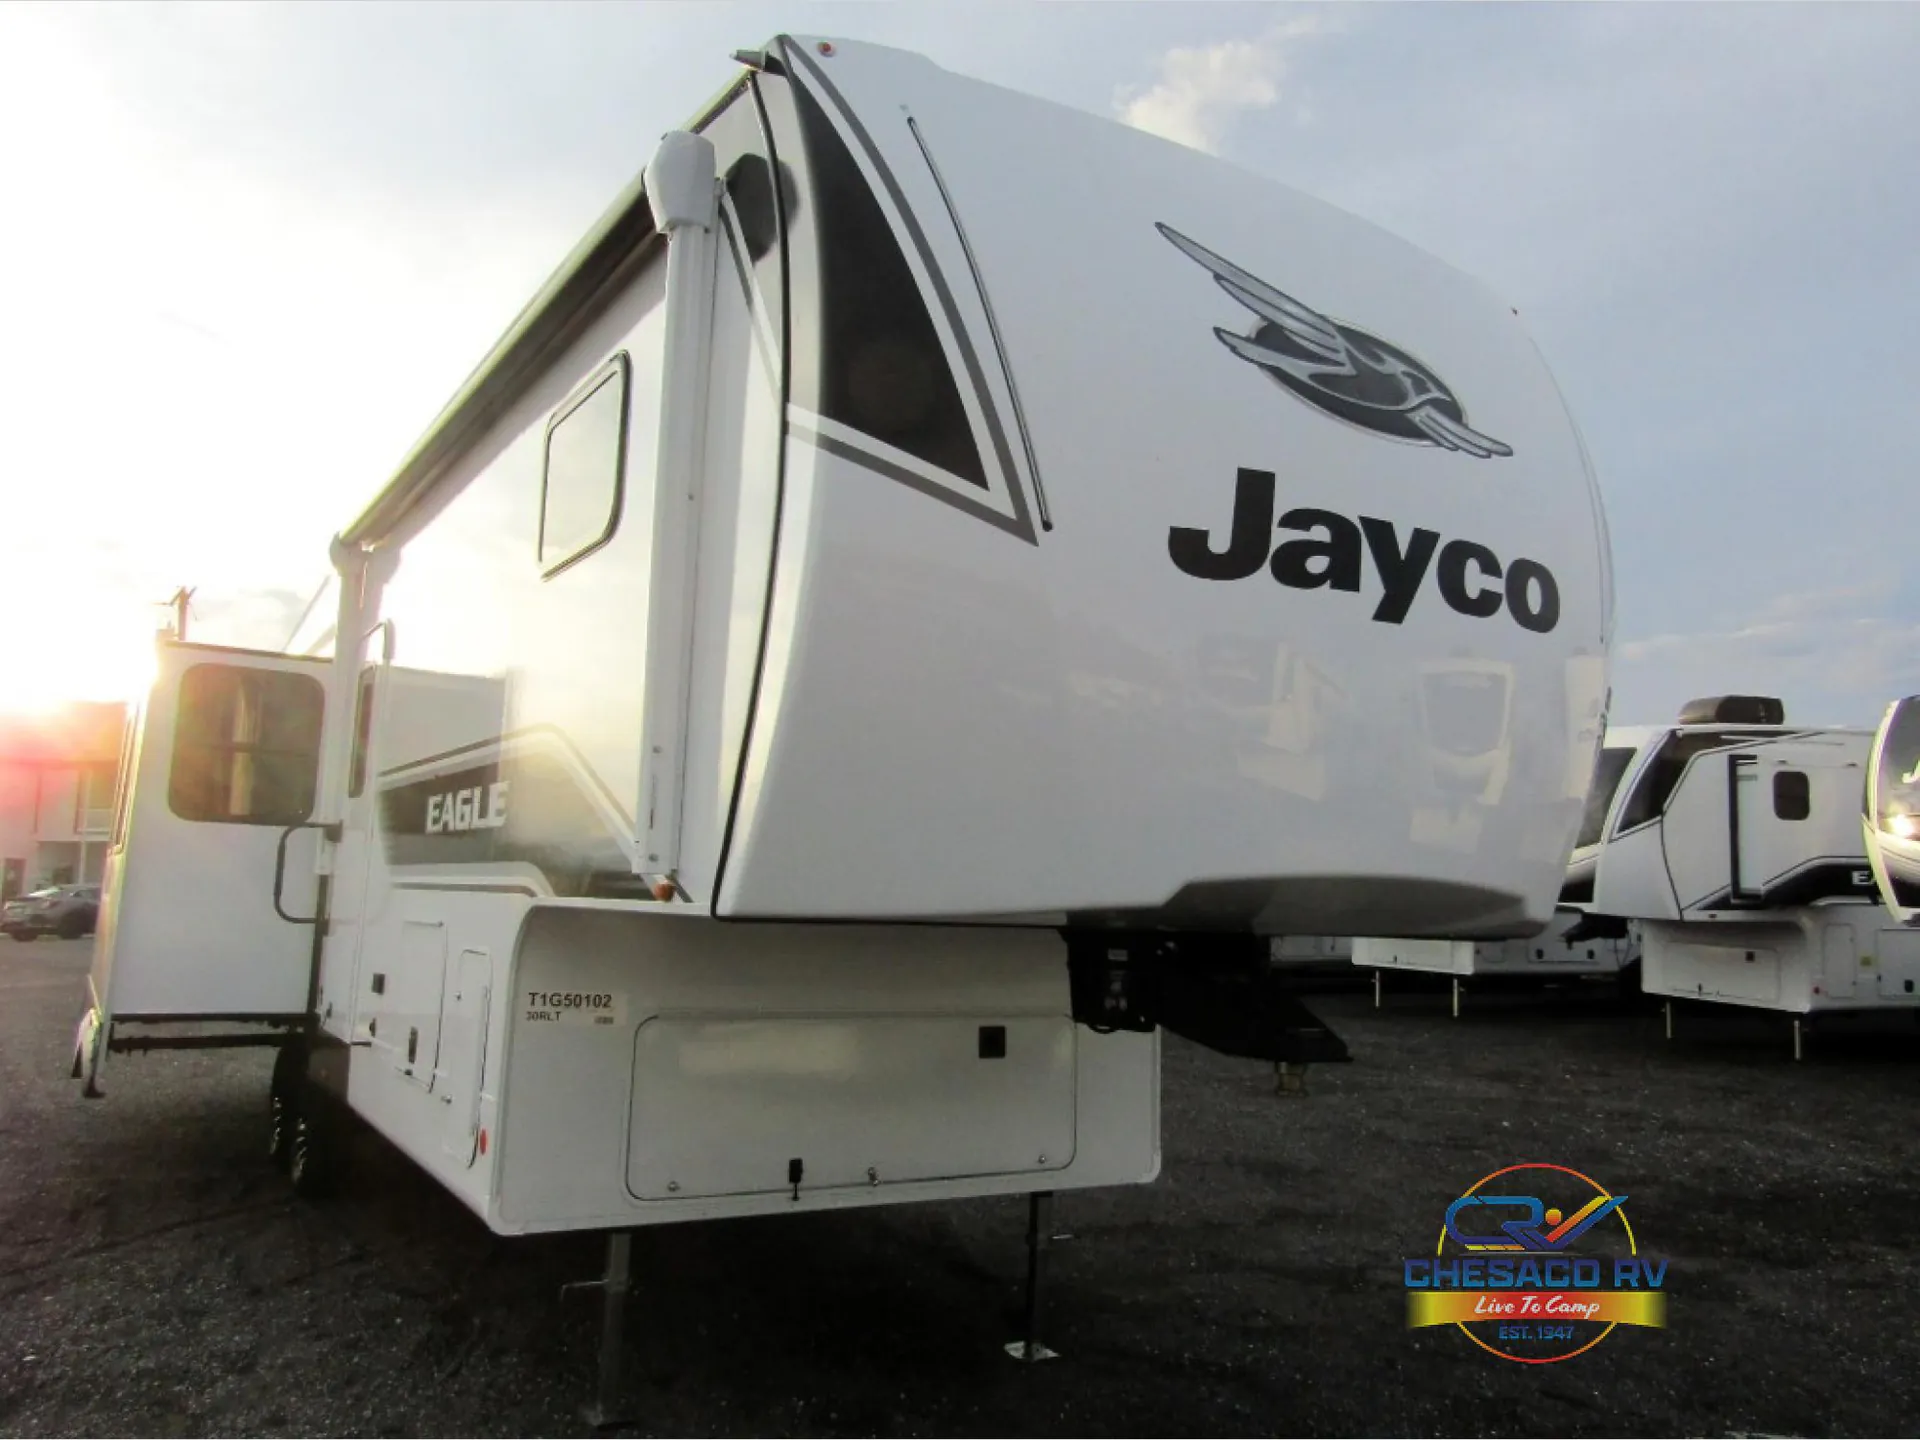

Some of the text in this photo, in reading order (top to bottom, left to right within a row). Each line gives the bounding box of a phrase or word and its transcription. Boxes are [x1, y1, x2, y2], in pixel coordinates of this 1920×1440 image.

[1168, 467, 1560, 633] Jayco
[425, 781, 510, 834] EAGLE
[528, 991, 612, 1009] T1G50102
